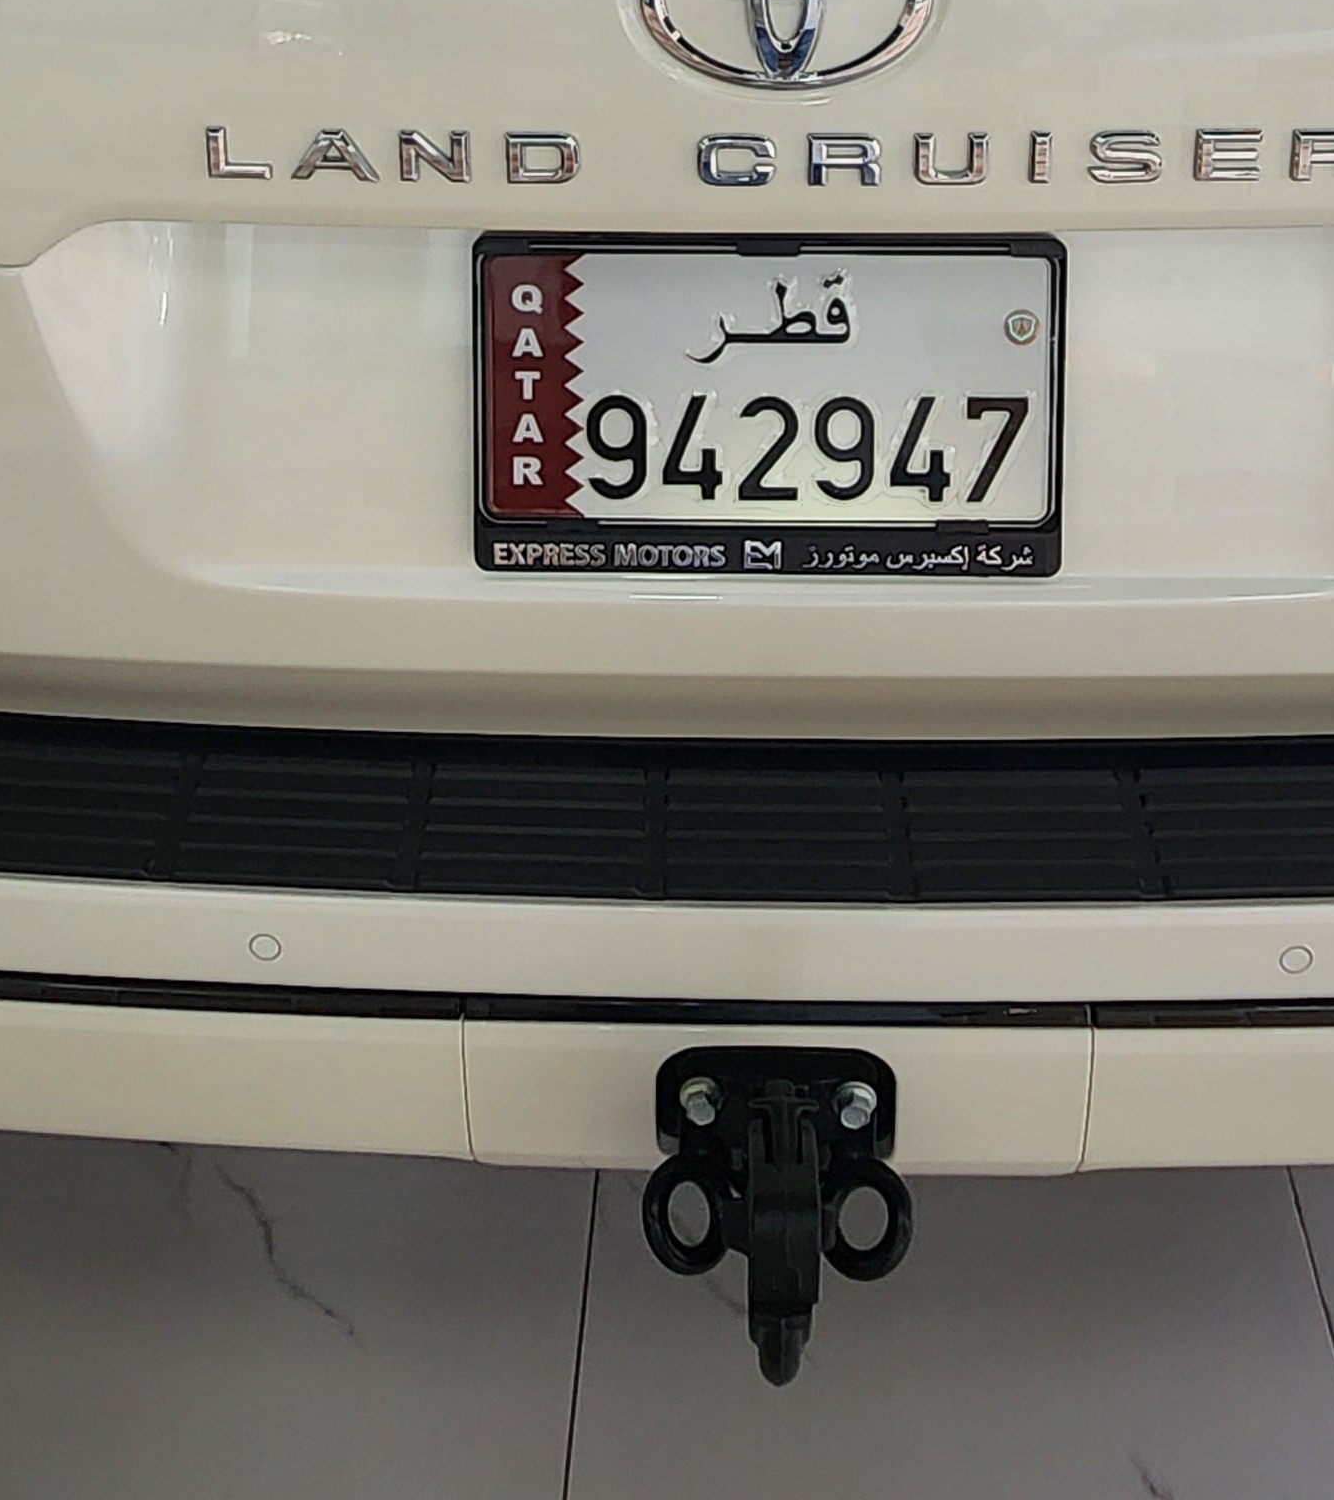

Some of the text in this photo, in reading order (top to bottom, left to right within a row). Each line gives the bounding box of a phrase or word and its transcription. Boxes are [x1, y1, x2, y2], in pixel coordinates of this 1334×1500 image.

[206, 126, 582, 184] LAND
[685, 273, 852, 363] قطر
[511, 284, 543, 487] QATAR
[585, 395, 1029, 502] 942947
[492, 542, 727, 569] EXPRESS MOTORS
[802, 545, 880, 569] موتورز
[975, 544, 1033, 571] شركة
